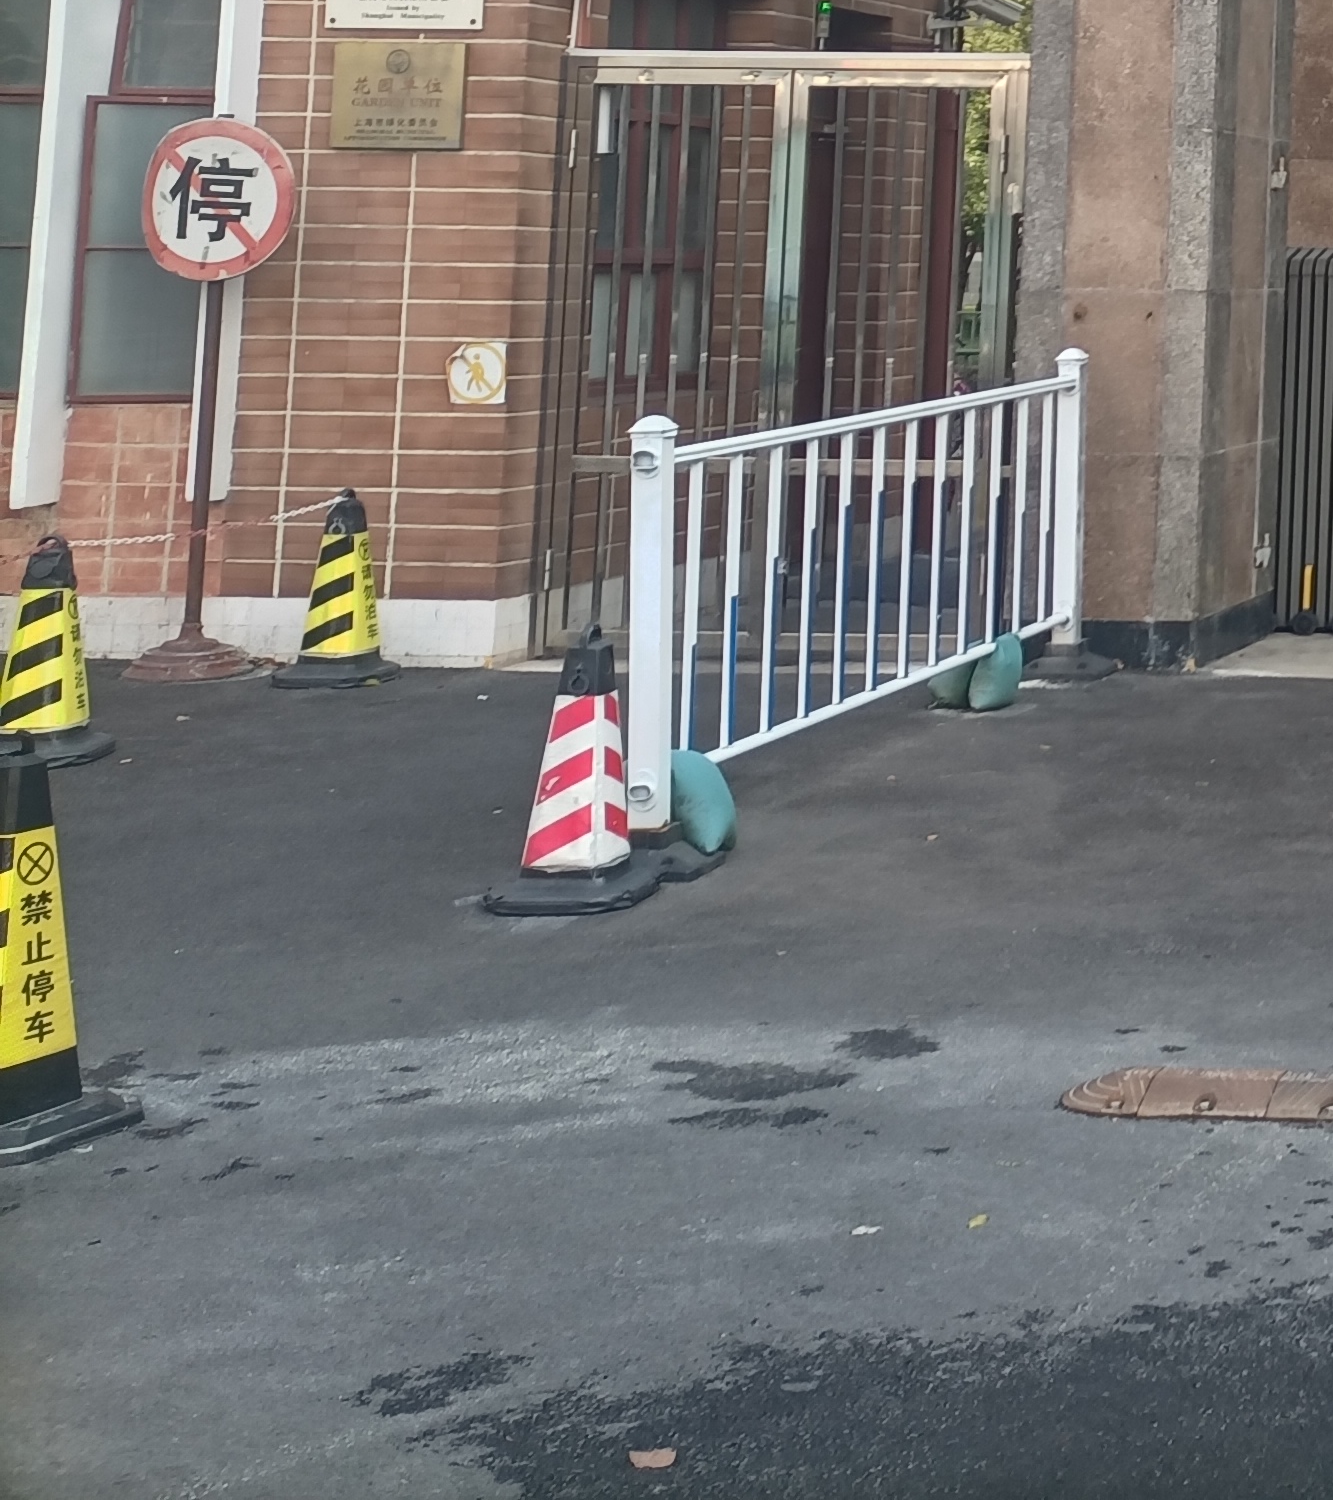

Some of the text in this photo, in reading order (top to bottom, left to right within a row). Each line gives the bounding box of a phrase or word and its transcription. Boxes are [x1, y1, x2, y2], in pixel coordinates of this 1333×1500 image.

[353, 75, 443, 95] 花园单位
[169, 155, 257, 243] 停
[20, 889, 55, 1044] 禁止停车
